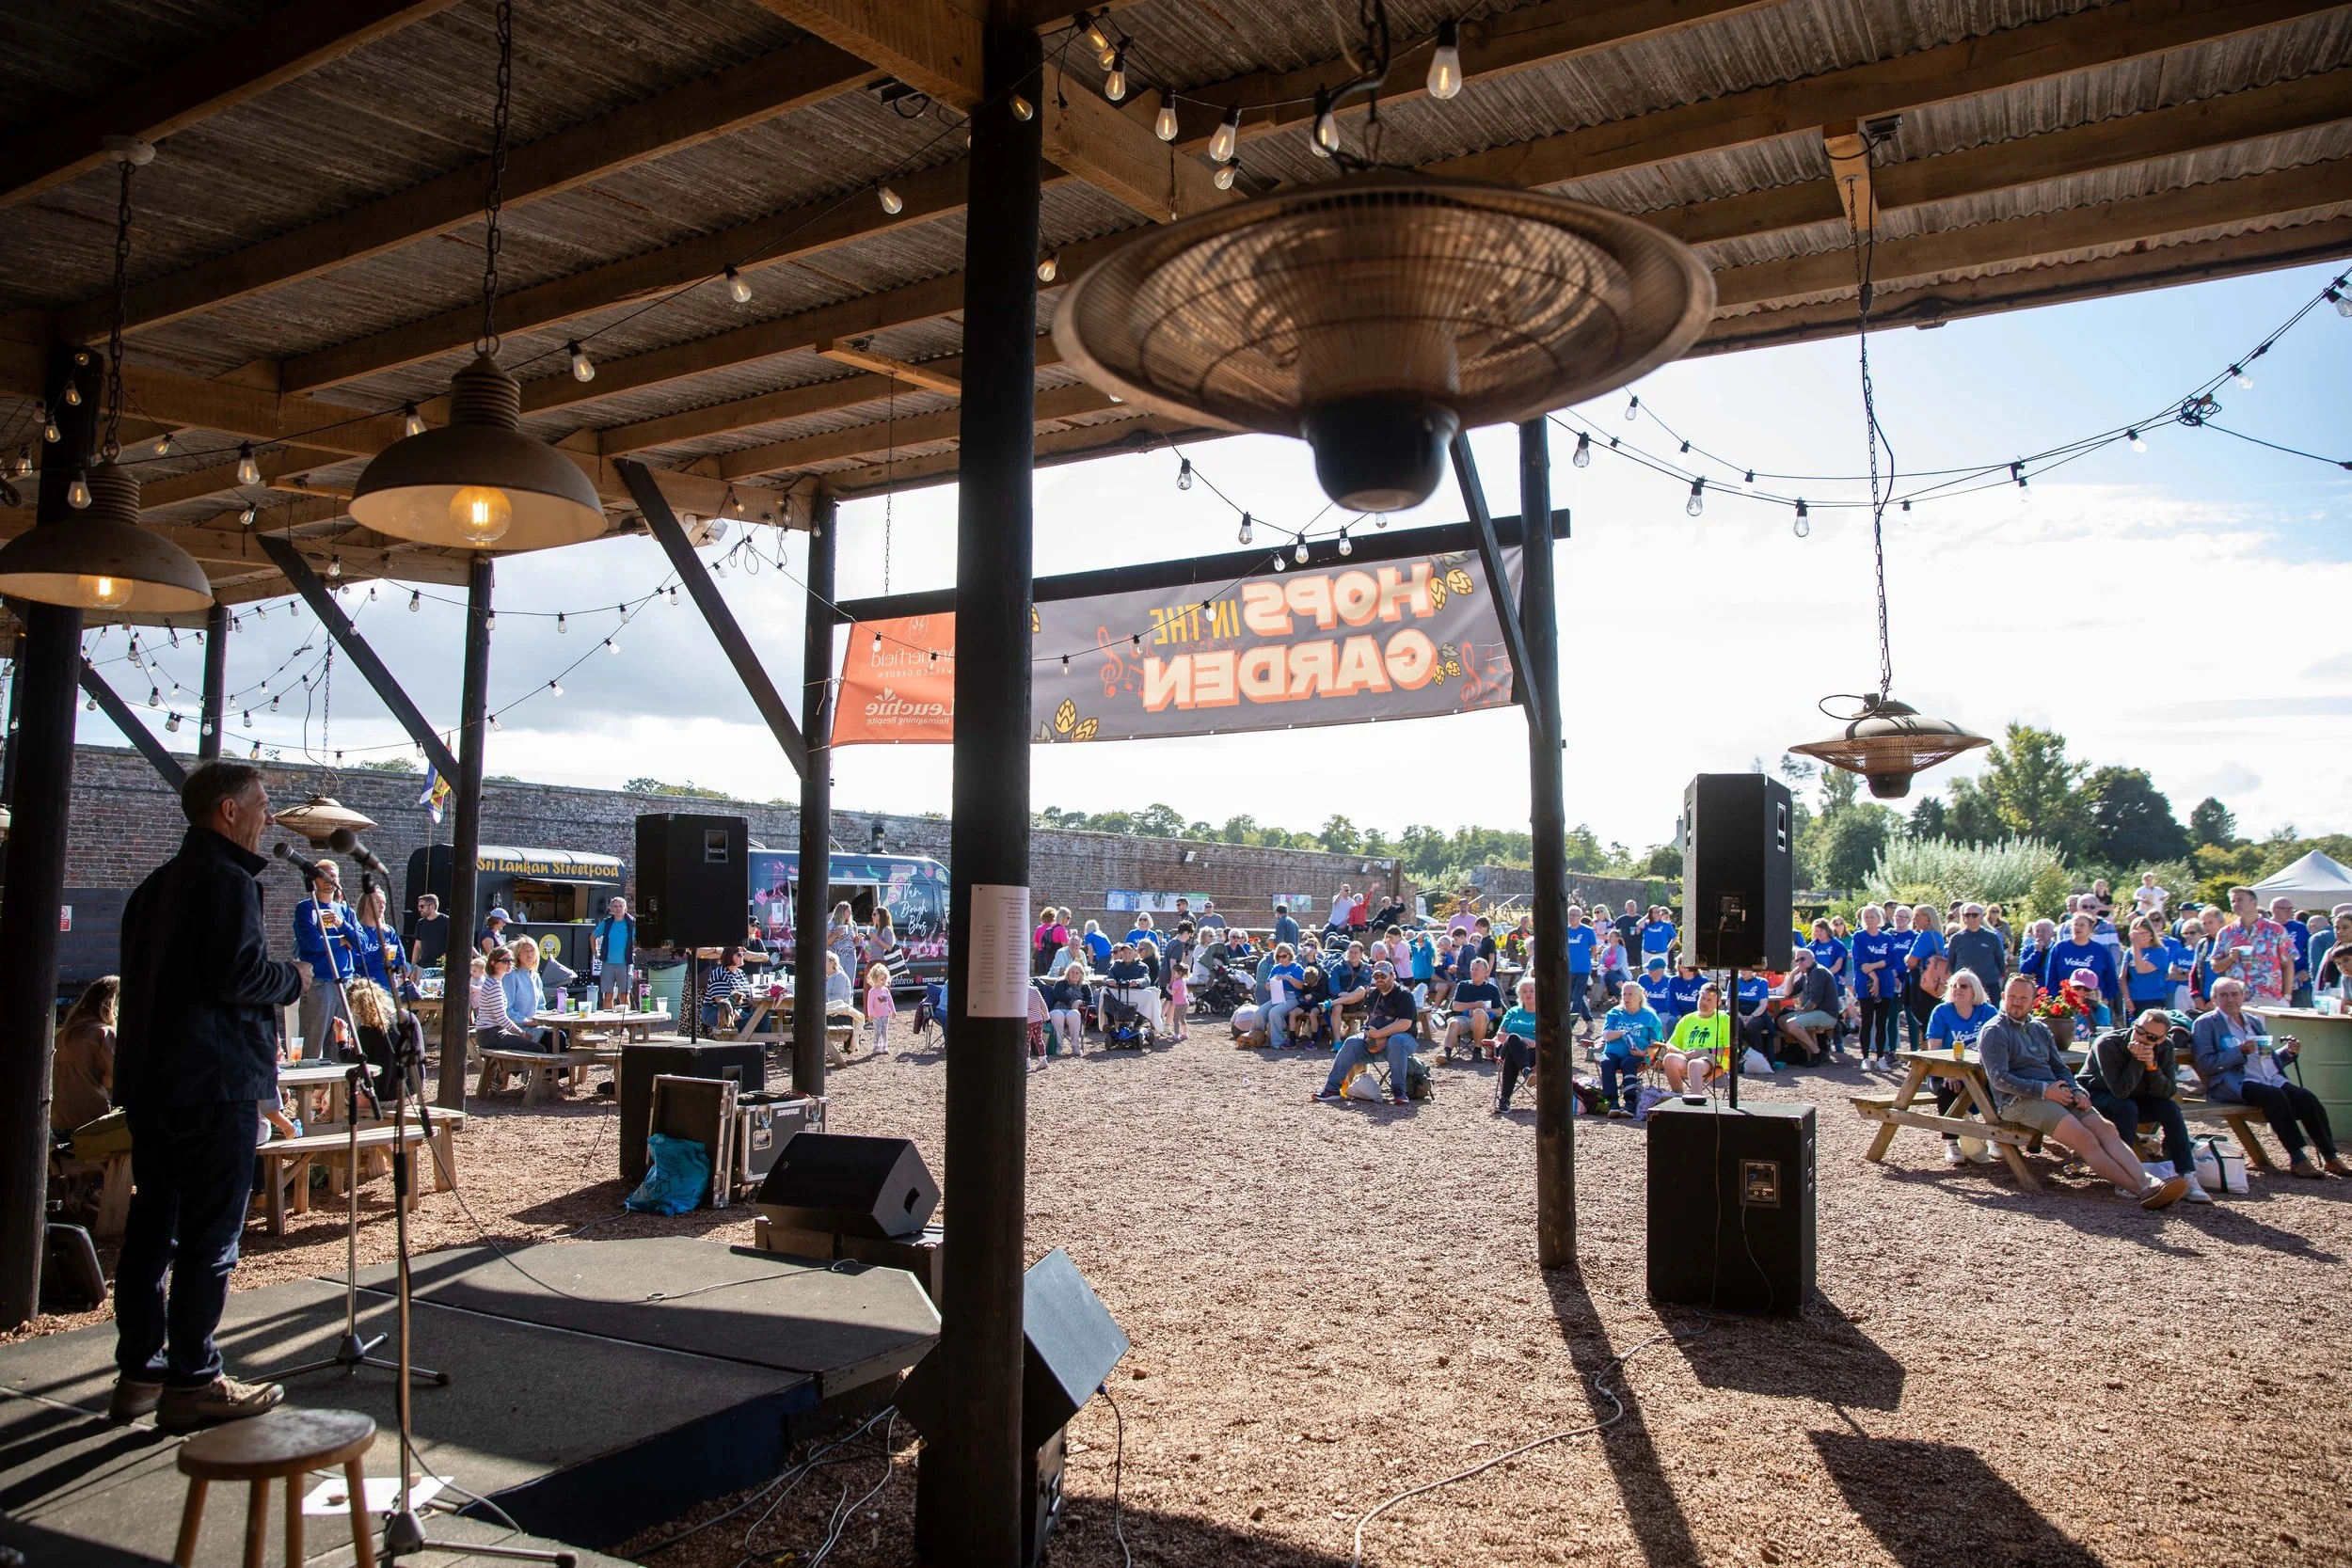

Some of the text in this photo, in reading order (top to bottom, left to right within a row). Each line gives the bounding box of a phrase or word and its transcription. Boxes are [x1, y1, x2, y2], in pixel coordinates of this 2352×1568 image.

[477, 857, 619, 878] Sri Lankan Streetfood
[903, 882, 922, 900] Van
[900, 898, 929, 922] Dough
[908, 915, 927, 937] Bros
[777, 1108, 800, 1117] SHURE
